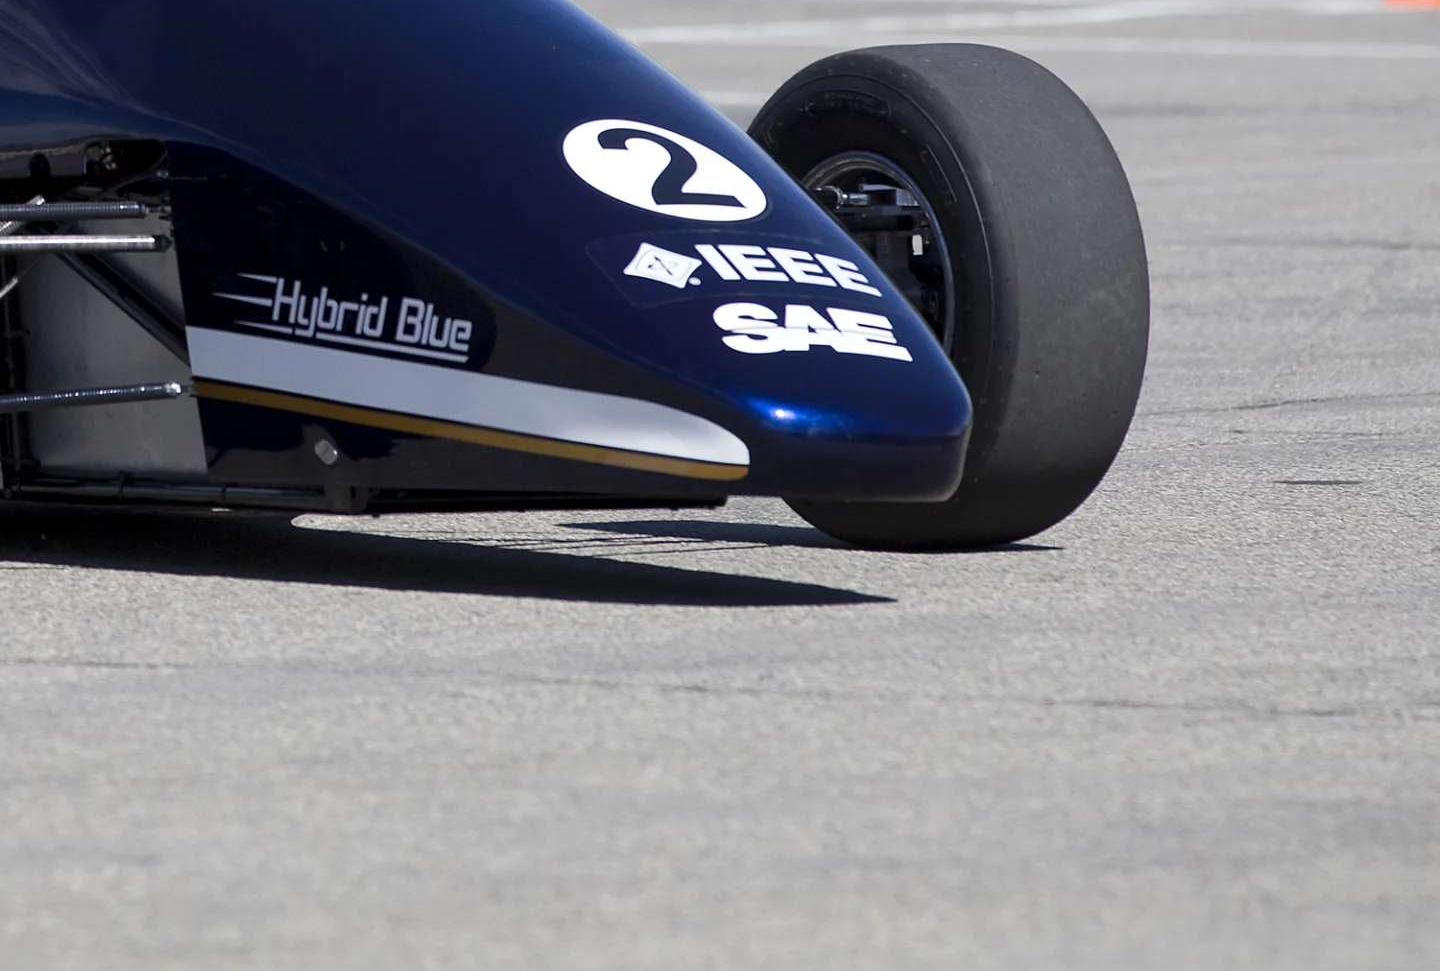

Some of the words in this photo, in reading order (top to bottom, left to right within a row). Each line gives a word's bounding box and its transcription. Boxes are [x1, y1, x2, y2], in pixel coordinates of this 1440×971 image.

[597, 127, 748, 207] 2
[693, 243, 883, 298] IEEE
[271, 277, 389, 338] Hybrid
[394, 297, 473, 353] Blue
[712, 302, 914, 362] SAE
